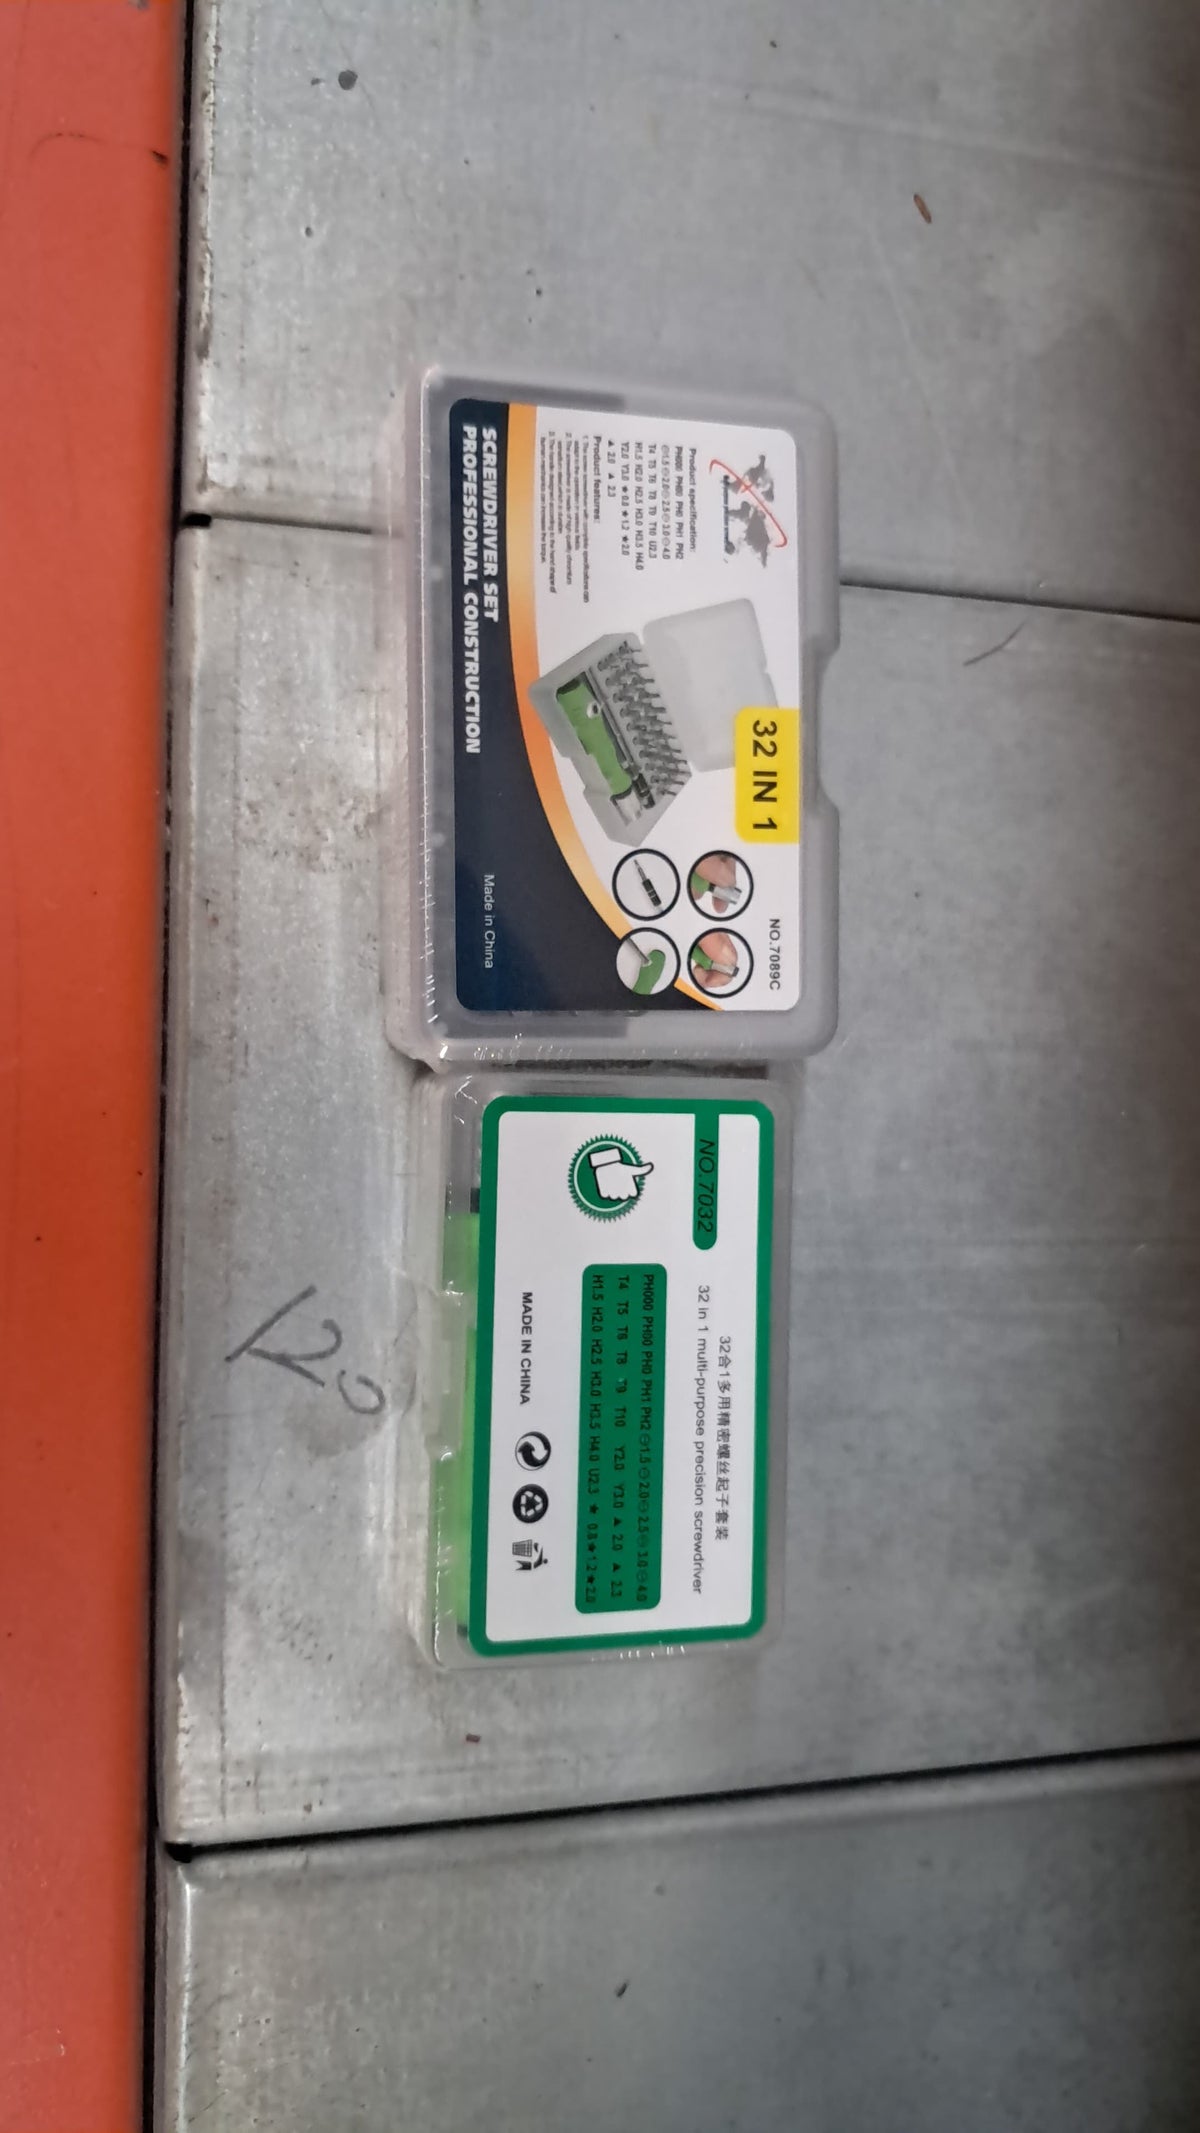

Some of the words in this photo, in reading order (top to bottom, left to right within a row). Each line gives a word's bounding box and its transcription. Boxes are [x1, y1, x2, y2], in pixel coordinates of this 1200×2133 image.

[593, 436, 602, 476] Product
[607, 451, 616, 464] 2.0
[621, 441, 629, 459] Y2.0
[634, 442, 643, 461] H1.5
[648, 444, 657, 454] T4
[621, 464, 629, 481] Y3.0
[634, 464, 643, 482] H2.0
[689, 448, 697, 485] Product
[607, 485, 616, 498] 2.3
[662, 478, 670, 489] 2.0
[462, 424, 478, 585] PROFESSIONAL
[482, 427, 498, 576] SCREWDRIVER
[634, 486, 643, 504] H2.5
[648, 506, 657, 516] T9
[662, 500, 670, 512] 2.5
[675, 501, 684, 518] PH0
[621, 520, 630, 530] 1.2
[635, 508, 644, 527] H3.0
[648, 521, 657, 536] T10
[662, 524, 670, 536] 3.0
[675, 522, 684, 538] PH1
[635, 530, 644, 548] H3.5
[621, 544, 630, 556] 2.0
[648, 541, 657, 559] U2.3
[662, 547, 671, 560] 4.0
[676, 543, 684, 560] PH2
[635, 552, 644, 571] H4.0
[483, 582, 499, 622] SET
[464, 592, 481, 754] CONSTRUCTION
[753, 719, 778, 758] 32
[753, 770, 778, 803] IN
[753, 817, 778, 831] 1
[483, 874, 496, 910] Made
[484, 915, 496, 926] in
[484, 930, 496, 968] China
[769, 918, 780, 990] NO.7089C
[697, 1139, 716, 1233] NO.7032
[592, 1274, 604, 1301] H1.5
[618, 1275, 630, 1290] T4
[642, 1274, 654, 1311] PH000
[698, 1285, 710, 1303] 32
[521, 1291, 533, 1335] MADE
[617, 1302, 629, 1315] T5
[697, 1307, 709, 1320] in
[591, 1306, 603, 1333] H2.0
[616, 1326, 628, 1341] T6
[642, 1316, 654, 1346] PH00
[521, 1339, 532, 1354] IN
[590, 1338, 602, 1365] H2.5
[616, 1351, 628, 1365] T8
[641, 1351, 653, 1375] PH0
[519, 1358, 532, 1405] CHINA
[589, 1371, 602, 1397] H3.0
[640, 1379, 652, 1402] PH1
[694, 1338, 708, 1436] multi-purpose
[589, 1403, 601, 1430] H3.5
[614, 1406, 626, 1428] T10
[640, 1406, 652, 1431] PH2
[714, 1336, 732, 1541] 32合1多用精密螺丝起子套装
[588, 1435, 600, 1462] H4.0
[614, 1445, 625, 1471] Y2.0
[639, 1446, 650, 1464] 1.5
[588, 1468, 600, 1495] U2.3
[693, 1441, 706, 1505] precision
[612, 1484, 624, 1509] Y3.0
[638, 1482, 649, 1499] 2.0
[637, 1516, 649, 1533] 2.5
[611, 1534, 623, 1551] 2.0
[637, 1551, 648, 1568] 3.0
[692, 1511, 705, 1594] screwdriver
[611, 1580, 623, 1598] 2.3
